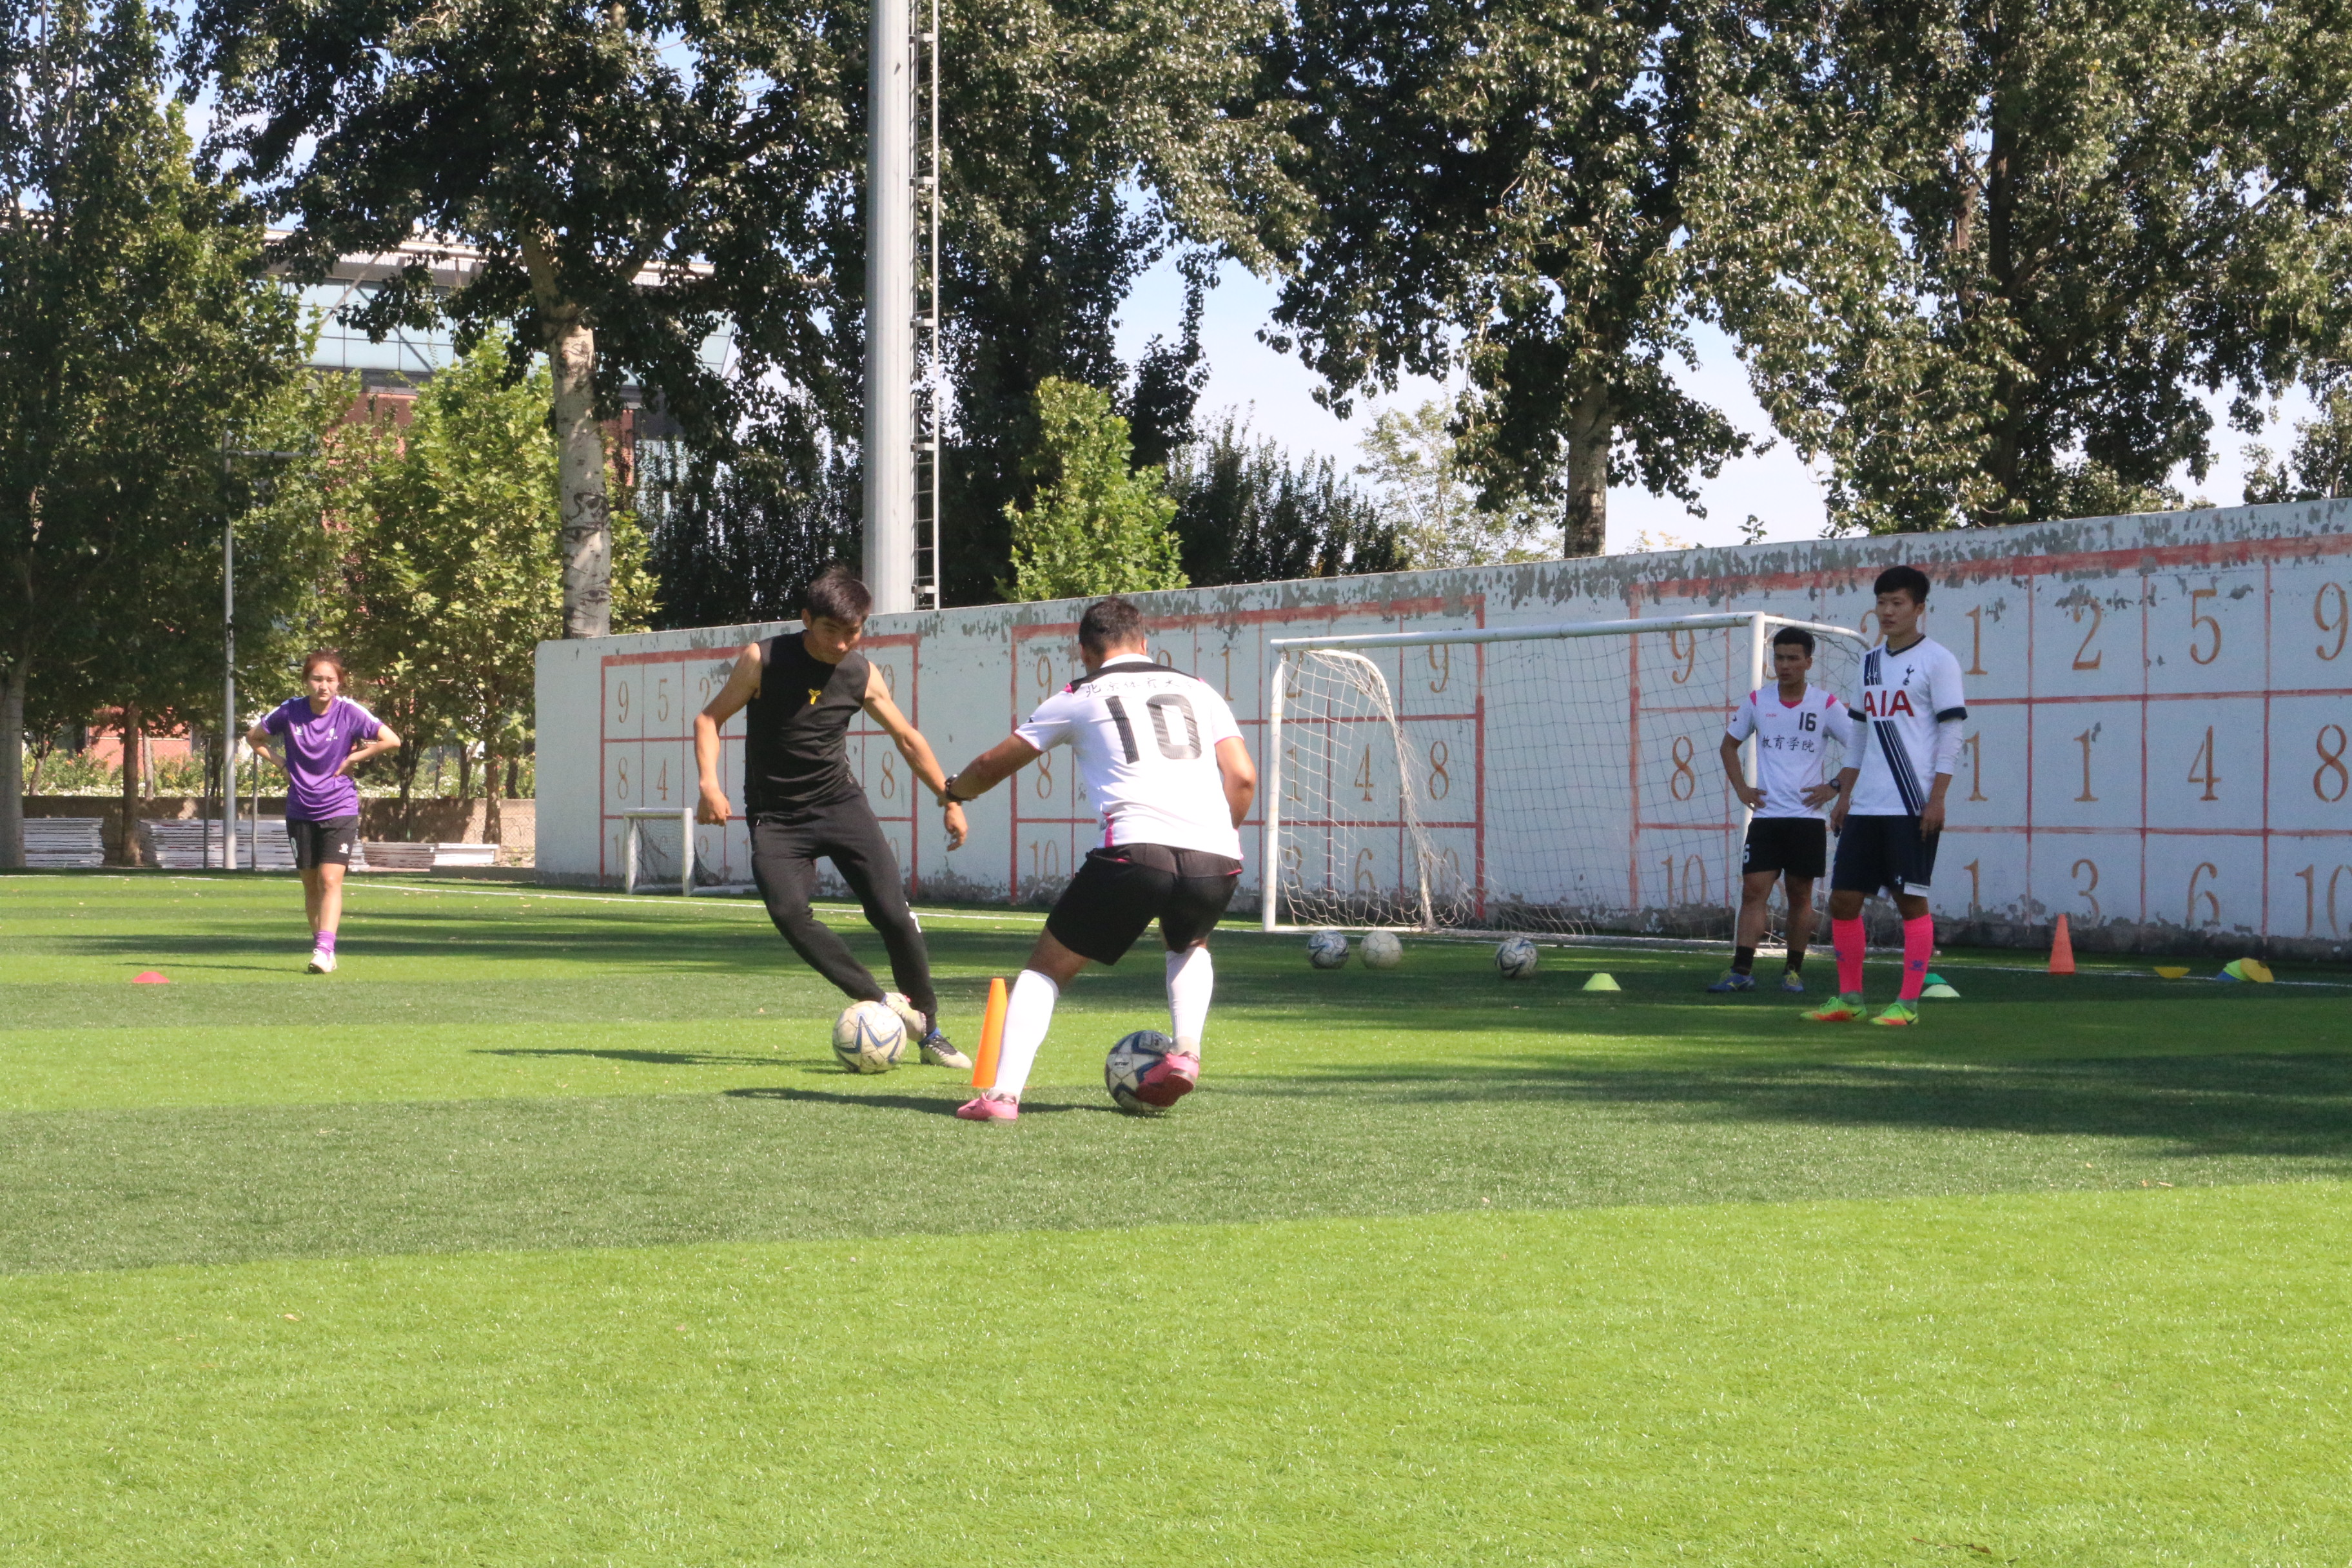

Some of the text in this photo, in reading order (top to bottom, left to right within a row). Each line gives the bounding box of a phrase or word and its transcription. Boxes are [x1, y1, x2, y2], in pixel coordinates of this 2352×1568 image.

[1965, 605, 1988, 674] 1
[2072, 598, 2102, 671] 2
[2190, 589, 2221, 665] 5
[2313, 582, 2349, 661] 9
[1037, 654, 1052, 704] 9
[1221, 648, 1234, 701] 1
[1429, 645, 1449, 693] 9
[1671, 630, 1695, 683] 9
[618, 680, 629, 723] 9
[658, 678, 669, 721] 5
[1799, 712, 1817, 731] 16
[1864, 689, 1915, 717] AIA
[1105, 693, 1202, 764] 10
[1762, 735, 1815, 752] 教育学院
[618, 757, 669, 801] 8 4
[881, 750, 895, 799] 8
[1037, 751, 1053, 799] 8
[1355, 743, 1375, 801] 4
[1429, 741, 1449, 799] 8
[1671, 736, 1694, 801] 8
[1965, 724, 2349, 802] 1 1 4 8
[1029, 840, 1059, 878] 10
[1660, 854, 1707, 905] 10
[1963, 858, 1979, 906] 1
[2186, 862, 2220, 926] 6
